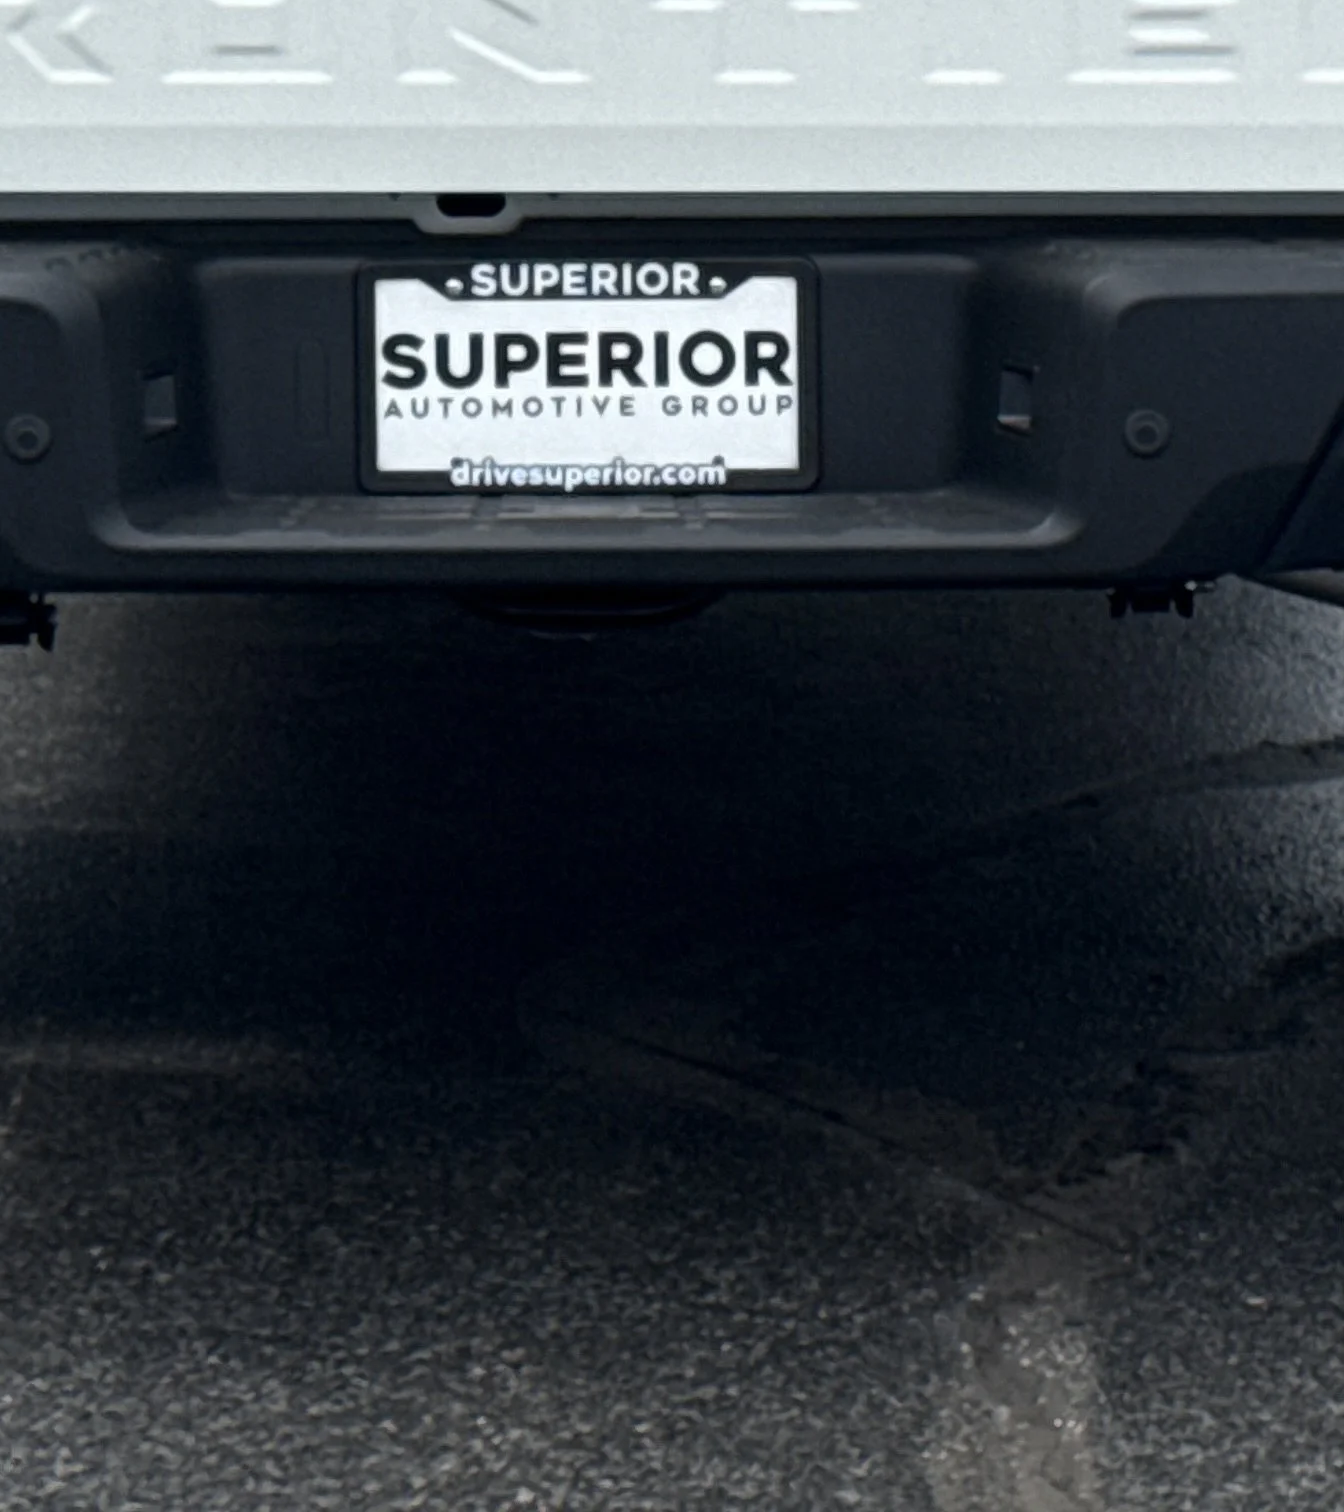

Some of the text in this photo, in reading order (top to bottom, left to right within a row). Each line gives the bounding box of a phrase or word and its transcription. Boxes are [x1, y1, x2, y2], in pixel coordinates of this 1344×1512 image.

[470, 262, 700, 296] SUPERIOR
[381, 331, 794, 389] SUPERIOR
[383, 395, 794, 419] AUTOMOTIVE GROUP
[450, 456, 727, 491] drivesuperior.com
